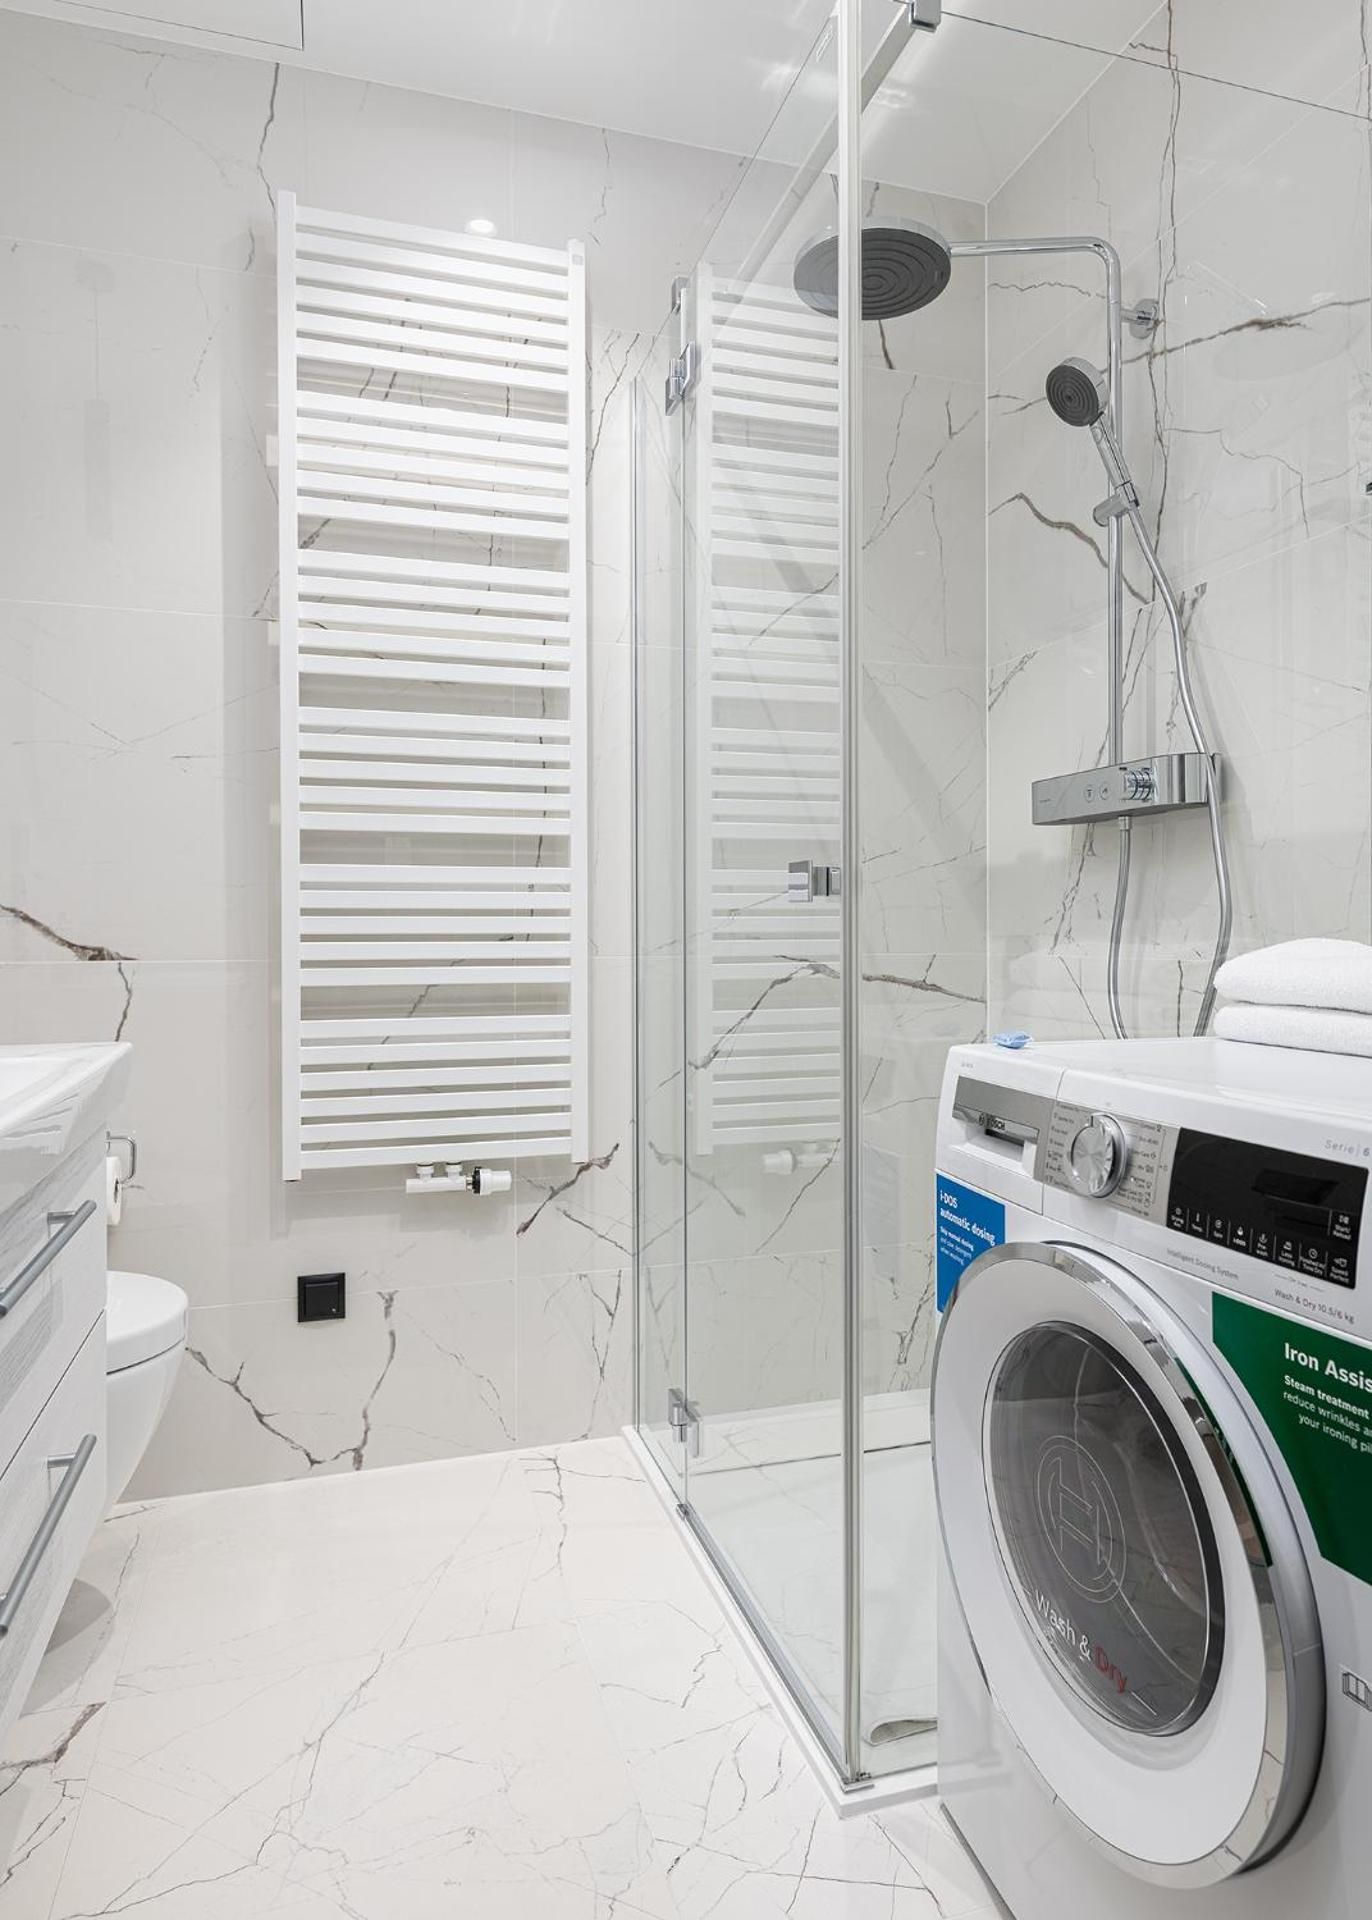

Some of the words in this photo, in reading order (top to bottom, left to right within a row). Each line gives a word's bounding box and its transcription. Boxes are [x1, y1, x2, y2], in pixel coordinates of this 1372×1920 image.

[1324, 1139, 1354, 1155] Serie
[1362, 1147, 1370, 1157] 6
[940, 1207, 971, 1231] automatic
[1274, 1288, 1294, 1301] Wash
[1295, 1295, 1301, 1304] &
[1303, 1298, 1316, 1311] Dry
[1344, 1311, 1355, 1325] kg
[1284, 1342, 1319, 1372] Iron
[1324, 1359, 1372, 1393] Assis
[1283, 1391, 1316, 1413] reduce
[1318, 1406, 1361, 1432] wrinkles
[1284, 1374, 1315, 1396] Steam
[1317, 1389, 1370, 1420] treatment
[1298, 1413, 1320, 1429] your
[1322, 1422, 1358, 1450] ironing
[1035, 1588, 1076, 1646] Wash
[1079, 1634, 1092, 1661] &
[1093, 1642, 1128, 1695] Dry
